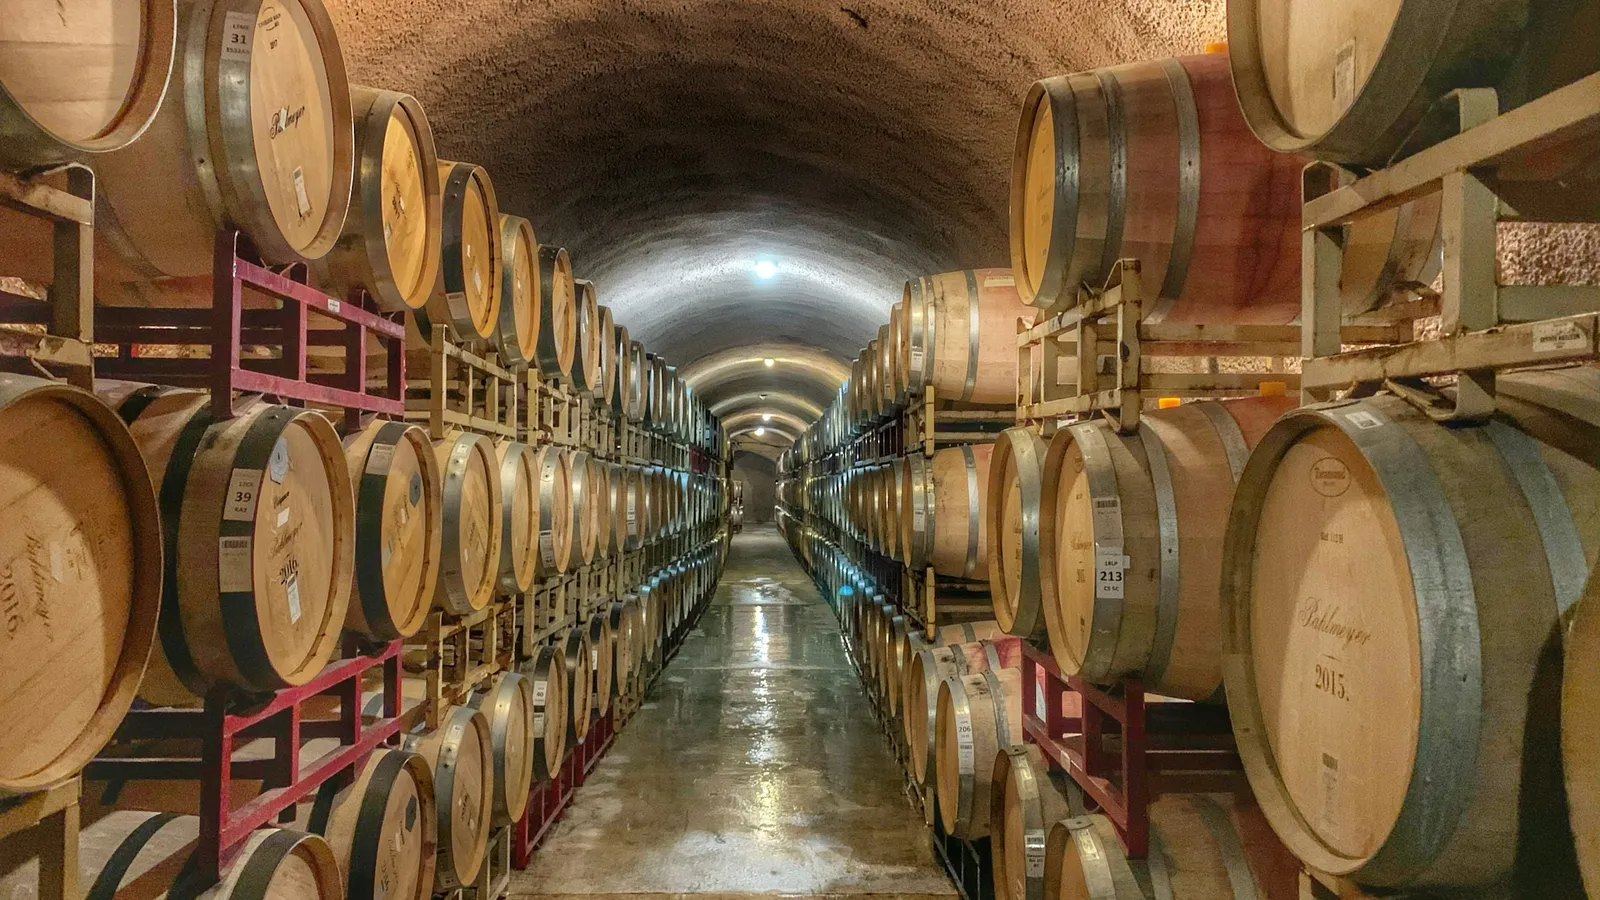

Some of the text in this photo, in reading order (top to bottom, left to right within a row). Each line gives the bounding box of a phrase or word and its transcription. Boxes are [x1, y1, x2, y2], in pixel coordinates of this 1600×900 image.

[231, 33, 247, 45] 31
[270, 105, 305, 139] Palmeyer
[234, 491, 252, 503] 39
[1100, 571, 1122, 581] 213
[1299, 596, 1372, 651] Pahlmeyer
[958, 725, 971, 733] 206
